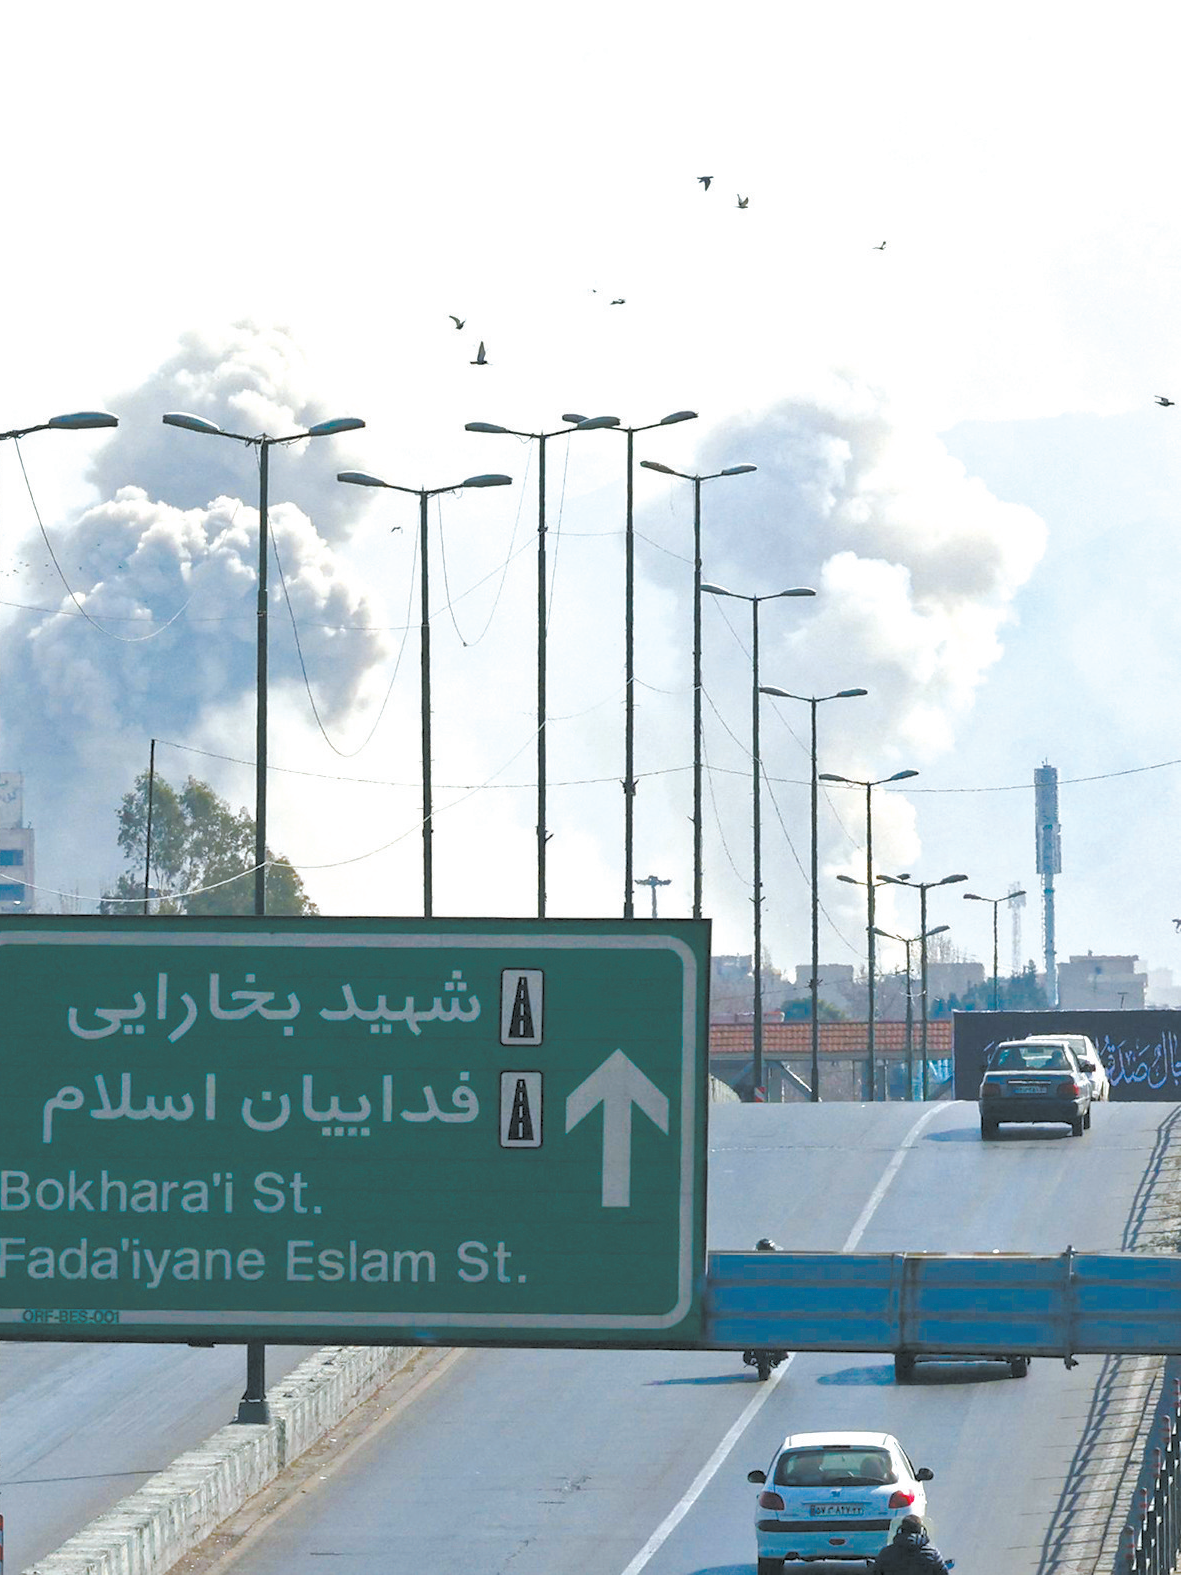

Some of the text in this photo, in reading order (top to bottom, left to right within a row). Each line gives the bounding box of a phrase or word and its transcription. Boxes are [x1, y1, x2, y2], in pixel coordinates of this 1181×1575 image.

[68, 970, 481, 1042] شهید بخارایی
[43, 1072, 480, 1143] فداییان اسلام
[0, 1169, 322, 1214] Bokhara'i St.
[0, 1237, 527, 1289] Fada'iyane Eslam St.
